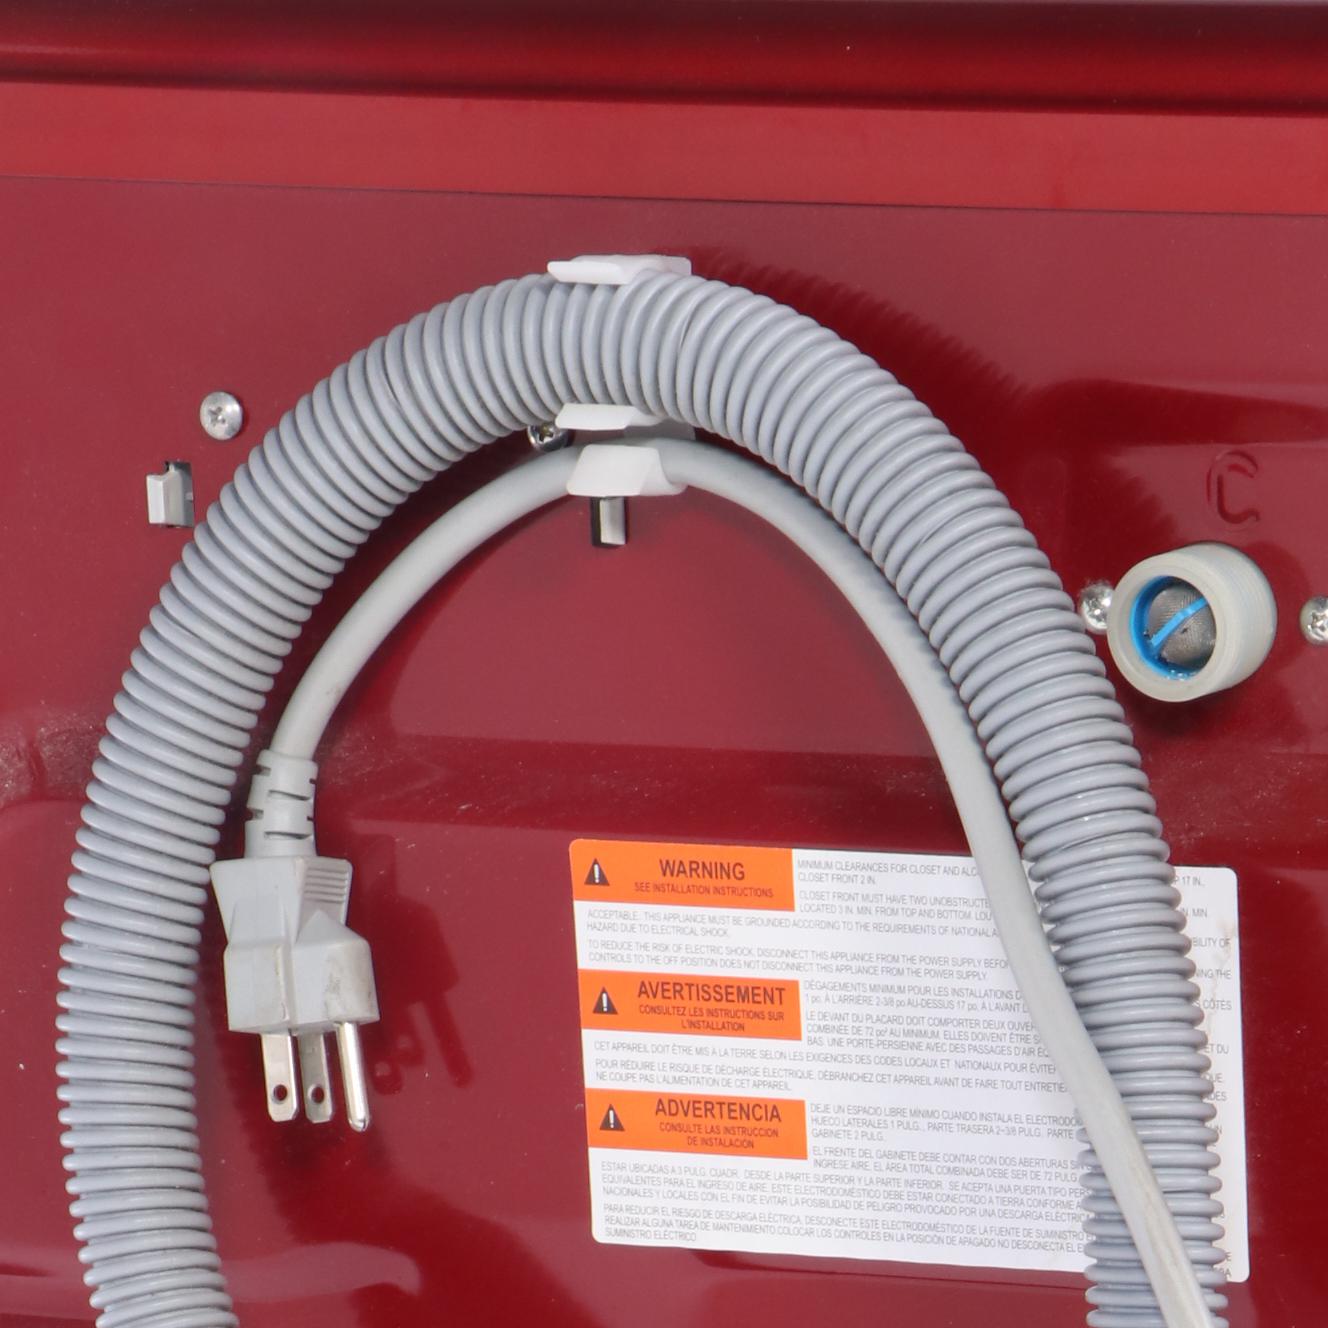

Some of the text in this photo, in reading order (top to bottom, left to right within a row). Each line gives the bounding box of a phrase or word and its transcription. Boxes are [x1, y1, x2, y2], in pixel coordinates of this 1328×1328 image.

[1206, 450, 1262, 528] C
[659, 859, 745, 880] WARNING
[798, 859, 960, 875] MINIMUM CLEARANCES FOR CLOSET AND
[798, 872, 875, 884] CLOSET FRONT 2 IN.
[634, 882, 773, 898] SEE INSTALLATION INSTRUCTIONS
[799, 890, 989, 908] CLOSET FRONT MUST HAVE TWO UNOBSTRUCTE
[800, 903, 971, 920] LOCATED 3 IN. MIN. FROM TOP AND BOTTOM.
[587, 921, 728, 937] HAZARD DUE TO ELECTRICAL SHOCK.
[637, 980, 785, 1005] AVERTISSEMENT
[638, 1004, 783, 1021] CONSULTEZ LES INSTRUCTIONS SUR
[681, 1019, 744, 1031] L'INSTALLATION
[654, 1098, 781, 1122] ADVERTENCIA
[659, 1122, 778, 1138] CONSULTE LAS INSTRUCCION
[687, 1136, 697, 1145] DE
